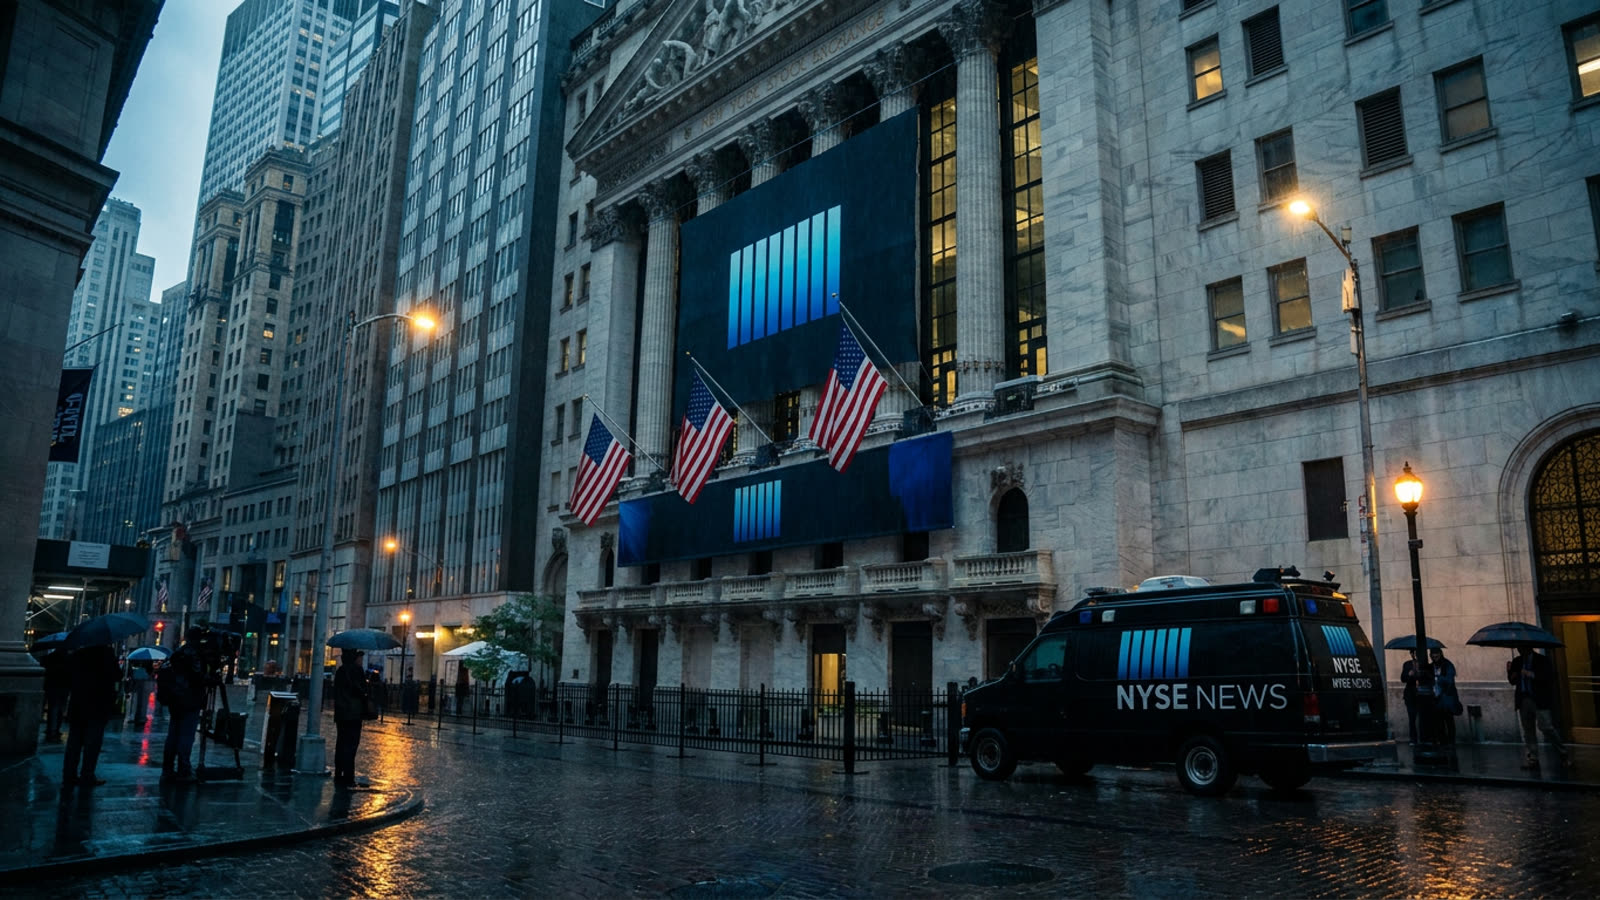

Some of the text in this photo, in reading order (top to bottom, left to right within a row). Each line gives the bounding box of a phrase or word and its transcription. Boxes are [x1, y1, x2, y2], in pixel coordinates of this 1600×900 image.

[1333, 657, 1362, 673] NYSE
[1116, 684, 1287, 710] NYSE NEWS
